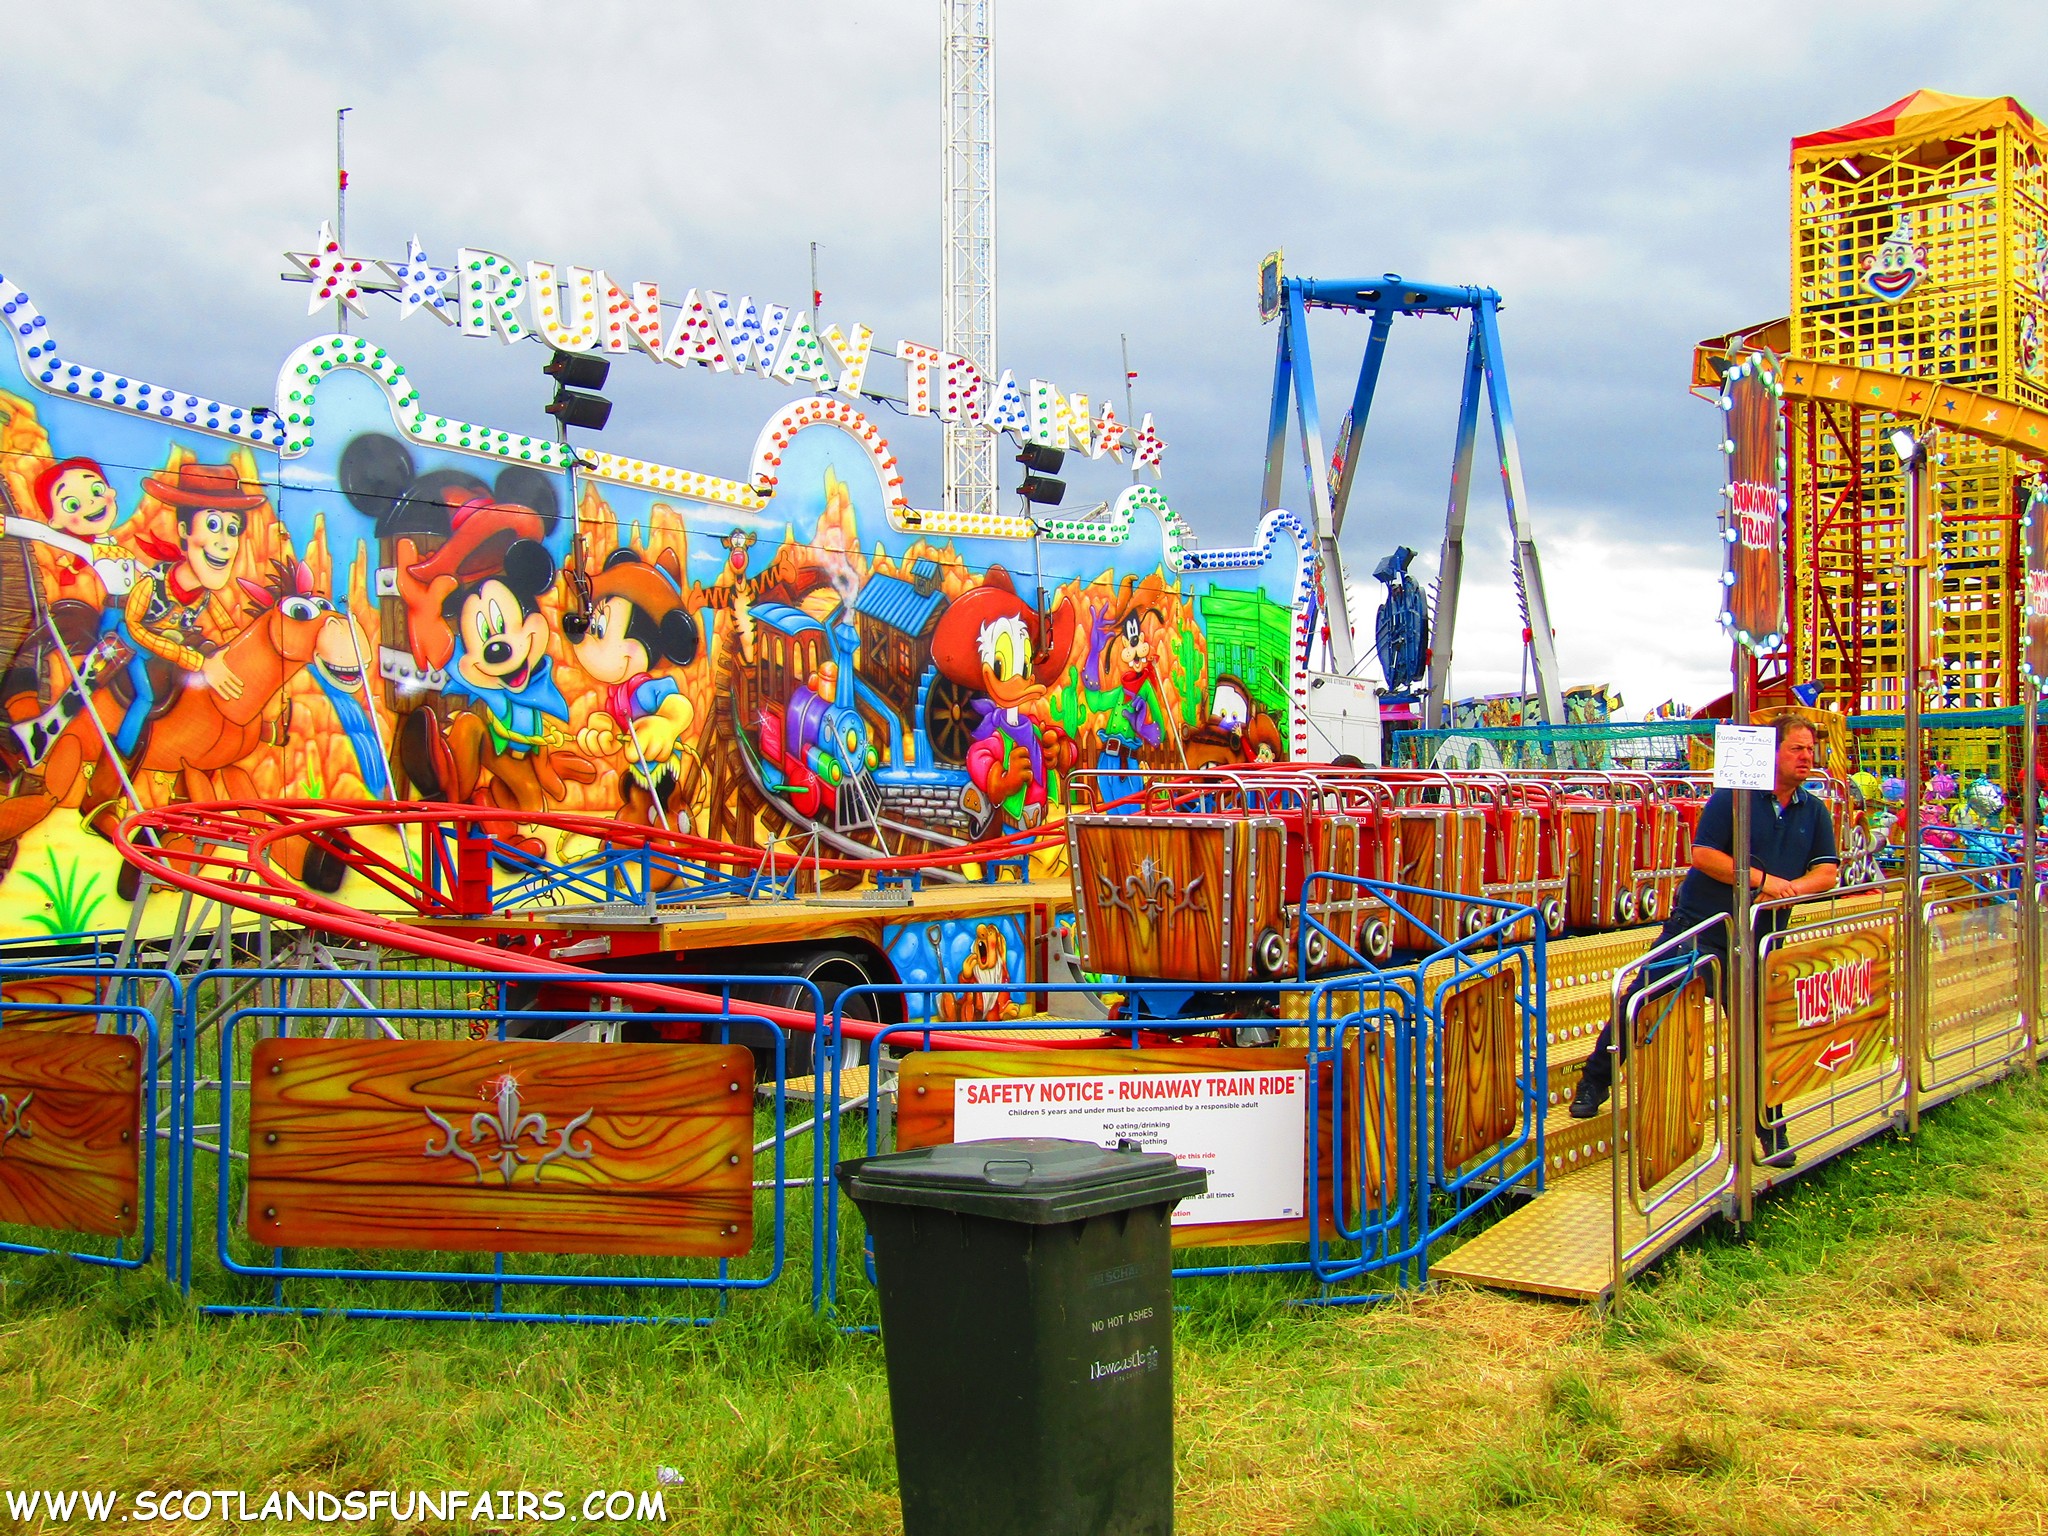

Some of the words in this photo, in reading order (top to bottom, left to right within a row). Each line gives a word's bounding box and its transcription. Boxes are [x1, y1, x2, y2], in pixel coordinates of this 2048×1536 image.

[457, 247, 874, 400] RUNAWAY
[896, 339, 1091, 458] TRAIN
[1732, 480, 1777, 522] RUNAWAY
[1741, 514, 1771, 552] TRAIN
[1716, 731, 1746, 745] Runaway
[1749, 735, 1772, 743] Train
[1719, 770, 1733, 778] Per
[1739, 770, 1766, 778] Person
[1794, 970, 1830, 1028] THIS
[1829, 959, 1858, 1025] WAY
[1856, 953, 1871, 1007] IN
[967, 1083, 1035, 1104] SAFETY
[1040, 1082, 1104, 1102] NOTICE
[1119, 1078, 1202, 1100] RUNAWAY
[1206, 1077, 1254, 1097] TRAIN
[1259, 1076, 1295, 1095] RIDE
[1136, 1104, 1183, 1114] accompanied
[1184, 1104, 1193, 1112] by
[1200, 1102, 1240, 1111] responsible
[1116, 1122, 1170, 1130] eating/drinking
[1128, 1130, 1158, 1138] smoking
[1092, 1320, 1104, 1332] NO
[1108, 1315, 1124, 1329] HOT
[1128, 1307, 1154, 1323] ASHES
[1090, 1350, 1146, 1380] Newcastle
